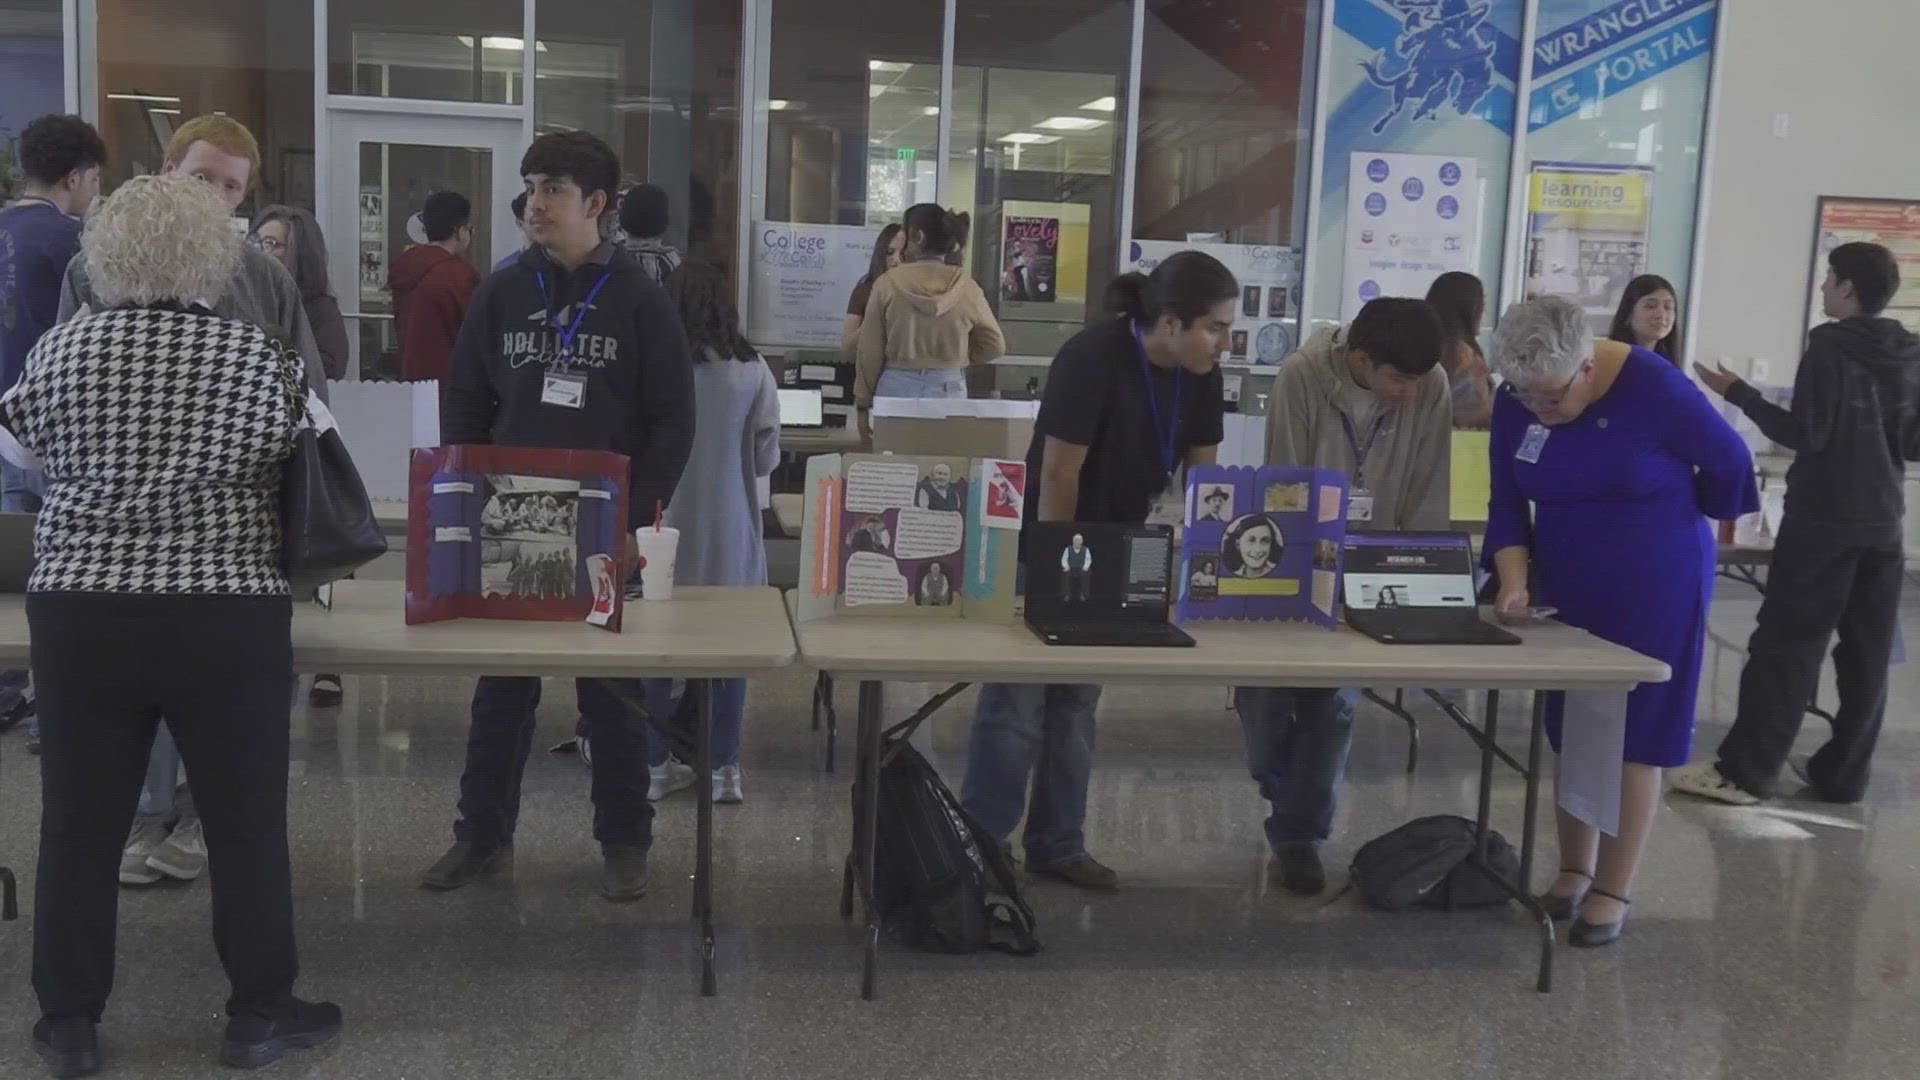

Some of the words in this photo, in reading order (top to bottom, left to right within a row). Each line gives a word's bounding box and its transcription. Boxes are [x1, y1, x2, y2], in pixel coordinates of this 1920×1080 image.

[1535, 0, 1692, 65] WRANGLE
[1594, 26, 1707, 84] PORTAL
[1543, 178, 1625, 202] learning
[1543, 197, 1611, 210] resources
[763, 229, 826, 254] College
[503, 331, 618, 360] HOLLITER
